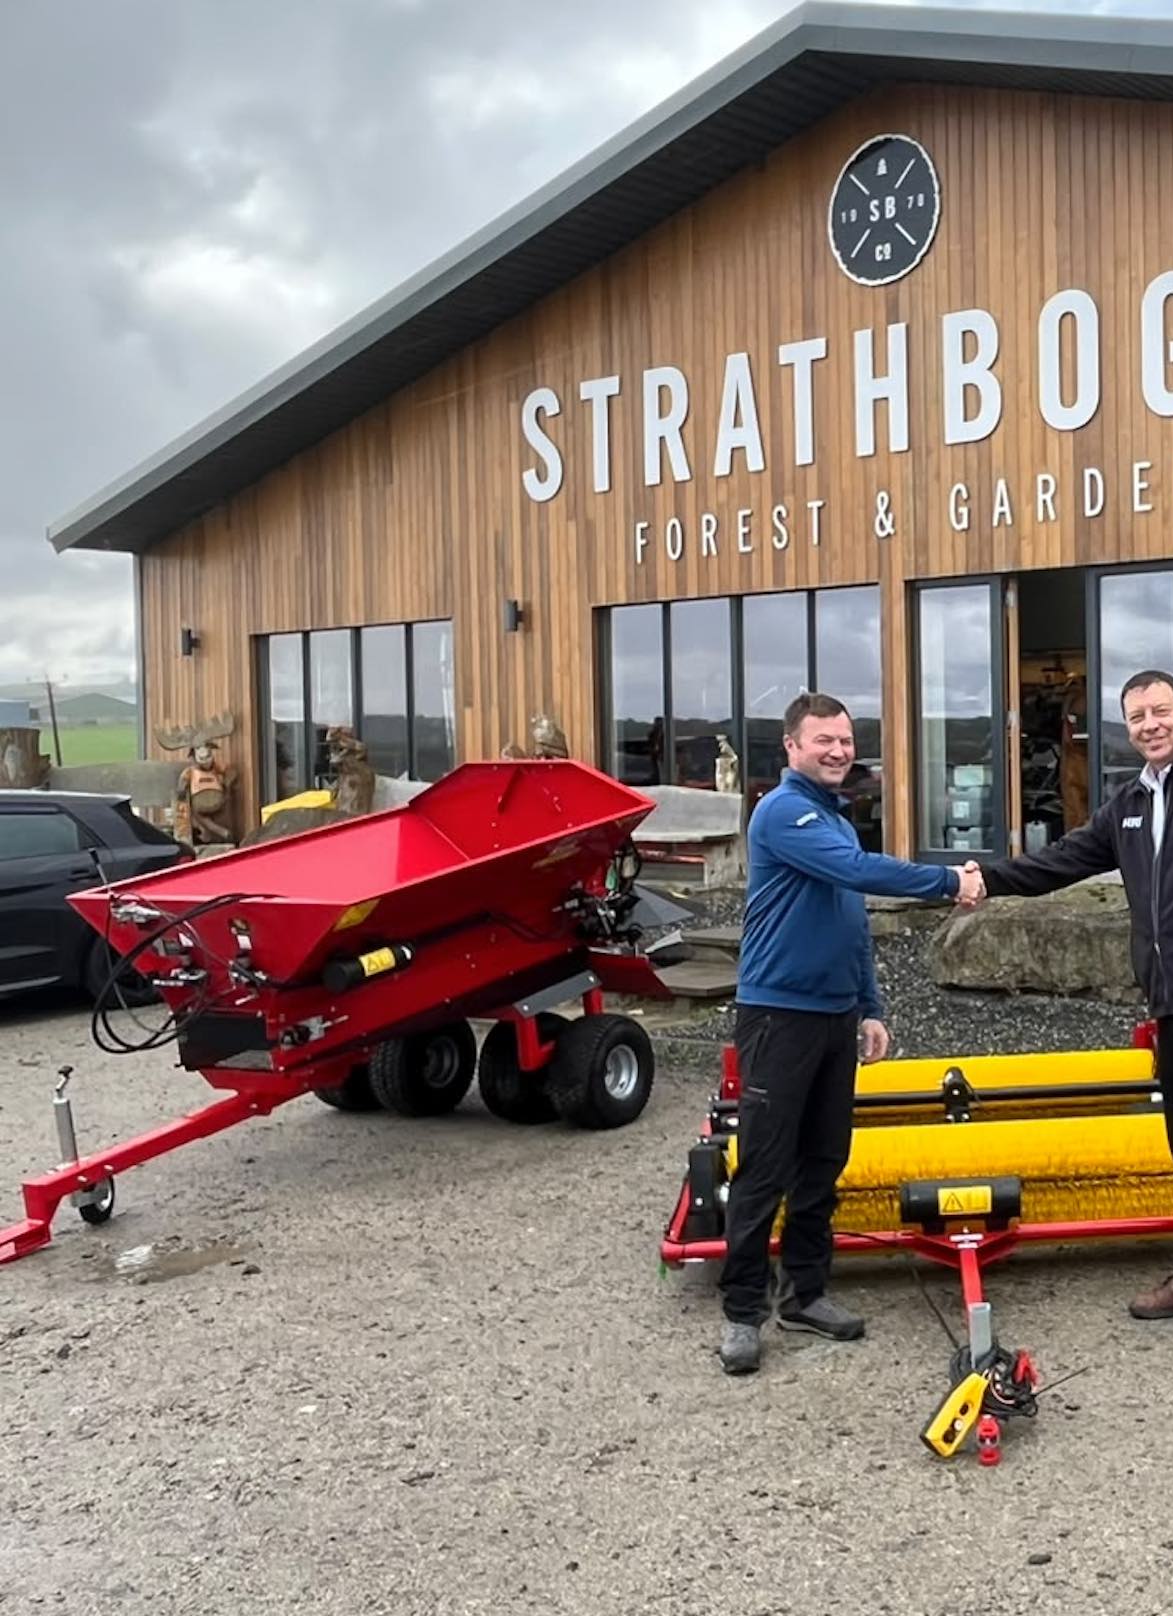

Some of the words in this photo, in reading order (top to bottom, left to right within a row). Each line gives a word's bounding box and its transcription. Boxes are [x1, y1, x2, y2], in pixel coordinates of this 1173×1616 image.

[869, 196, 896, 222] SB
[635, 500, 825, 565] FOREST
[874, 490, 896, 539] &
